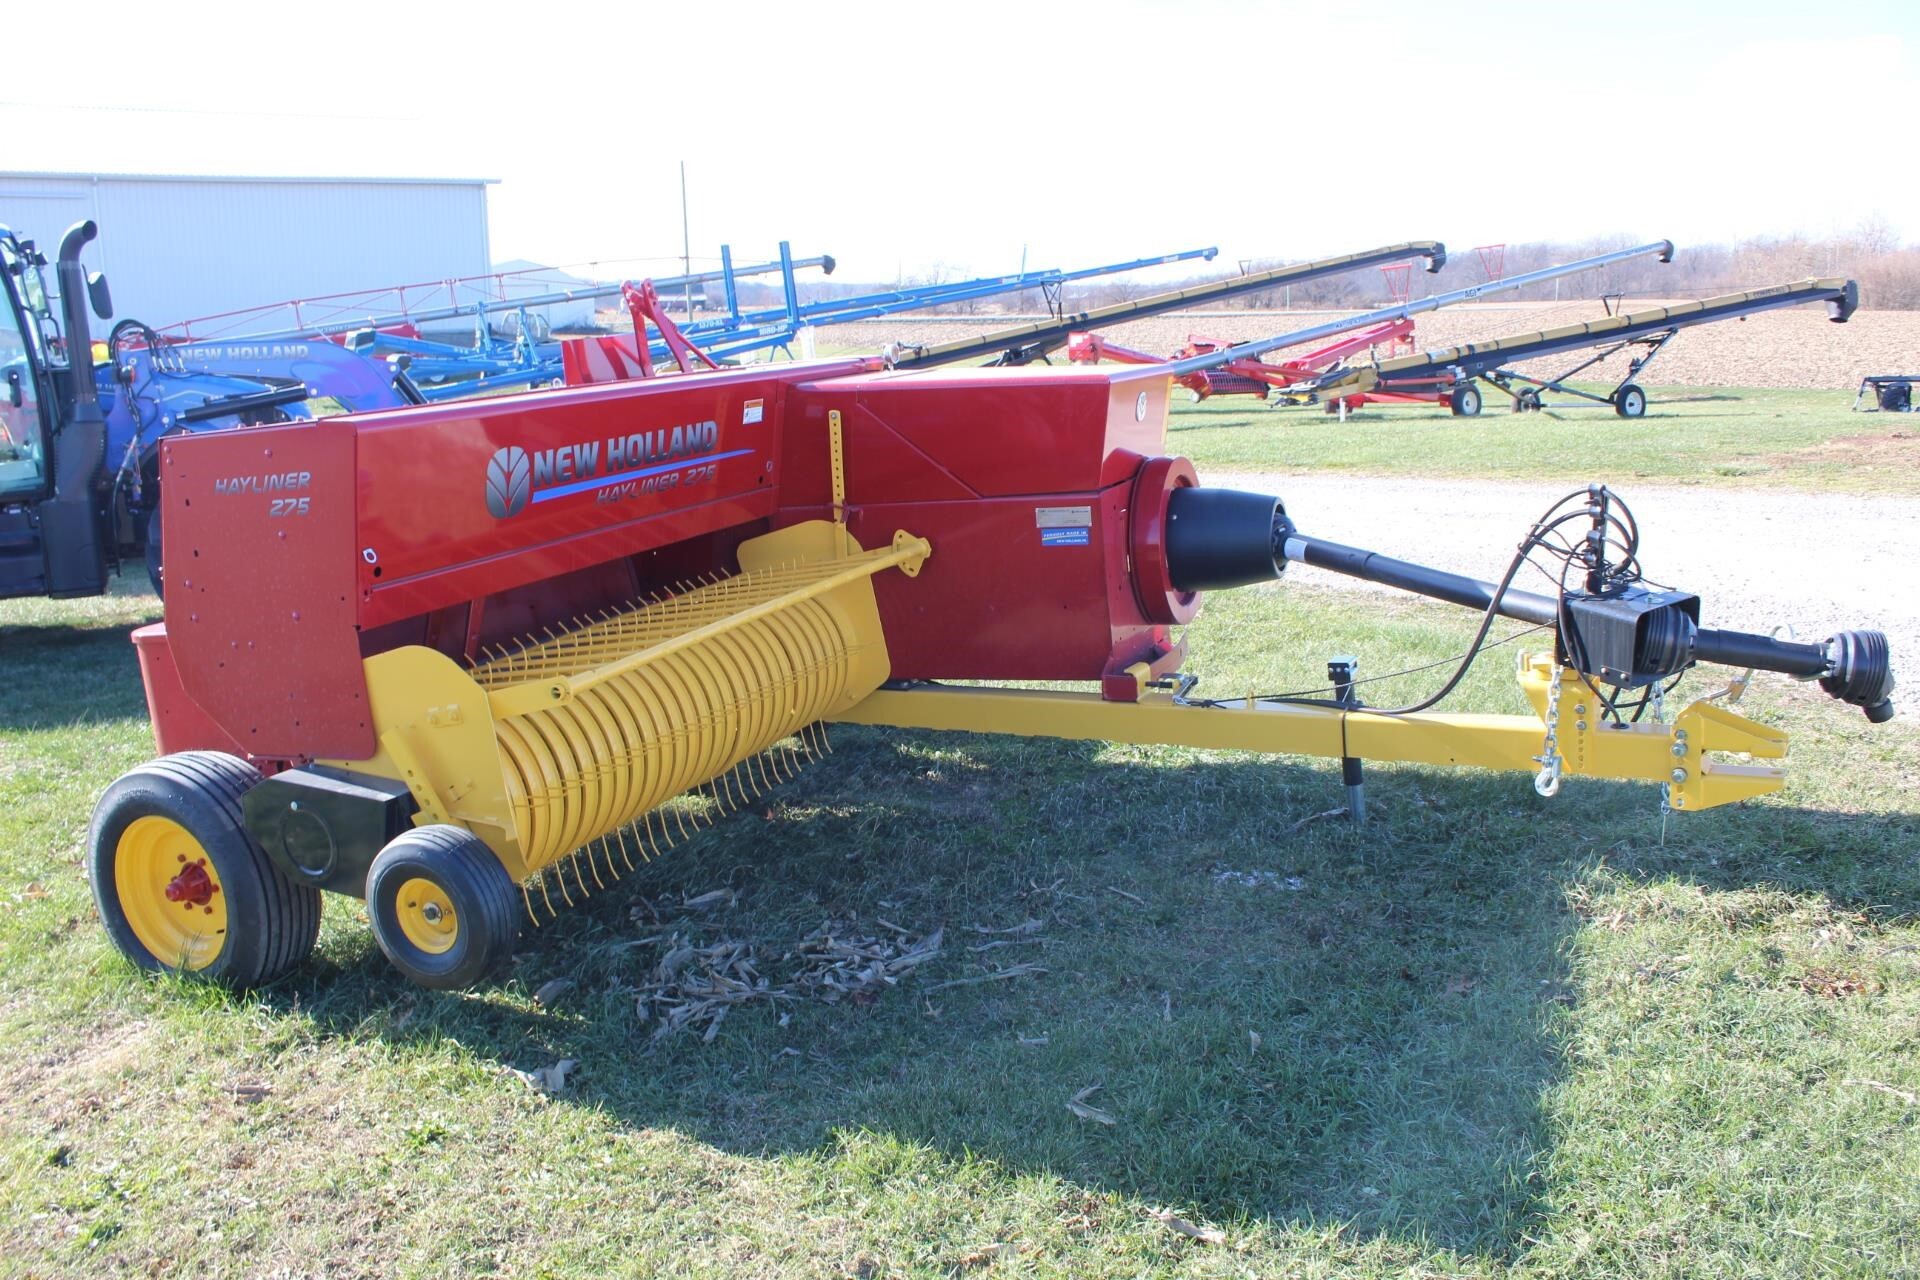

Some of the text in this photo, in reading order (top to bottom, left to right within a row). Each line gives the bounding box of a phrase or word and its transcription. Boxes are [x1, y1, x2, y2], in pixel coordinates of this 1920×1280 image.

[180, 344, 309, 361] NEW HOLLAND
[533, 420, 717, 488] NEW HOLLAND
[215, 471, 311, 517] HAYLINER 275
[597, 464, 717, 505] HAYLINER 275
